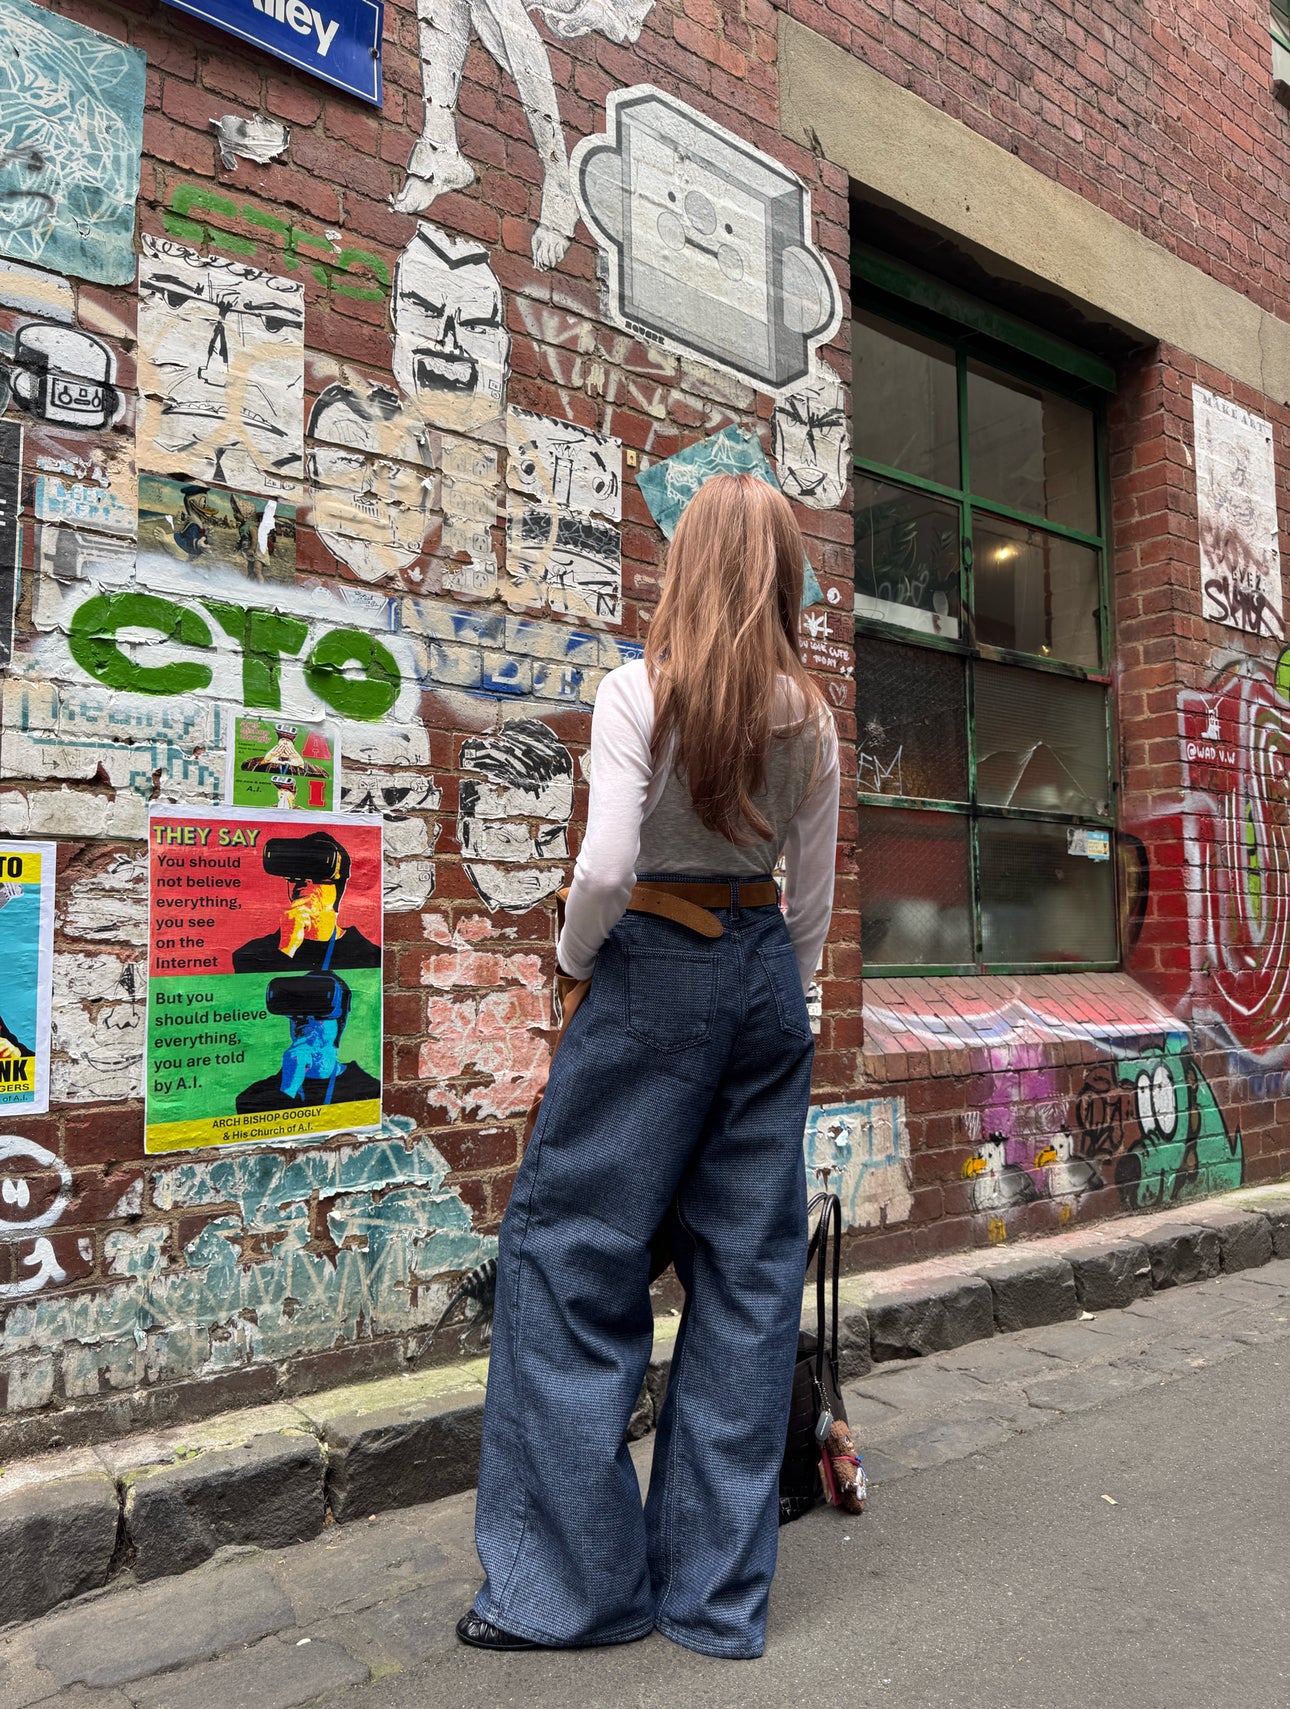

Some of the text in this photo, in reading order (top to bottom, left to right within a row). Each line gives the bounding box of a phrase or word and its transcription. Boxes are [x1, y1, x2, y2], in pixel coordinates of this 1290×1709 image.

[68, 591, 402, 722] CTO
[1187, 743, 1216, 760] @WAD
[152, 825, 261, 847] THEY SAY
[157, 855, 241, 868] You should
[157, 876, 241, 888] not believe
[156, 896, 242, 910] everything,
[156, 918, 215, 931] you see
[156, 936, 205, 949] on the
[156, 956, 218, 969] Internet
[156, 992, 214, 1006] But you
[155, 1009, 267, 1026] should believe
[154, 1032, 241, 1049] everything,
[154, 1051, 245, 1073] you are told
[154, 1076, 202, 1094] by A.I.
[212, 1108, 322, 1128] ARCH BISHOP GOOGLY
[223, 1122, 313, 1141] & His Church of A.I.
